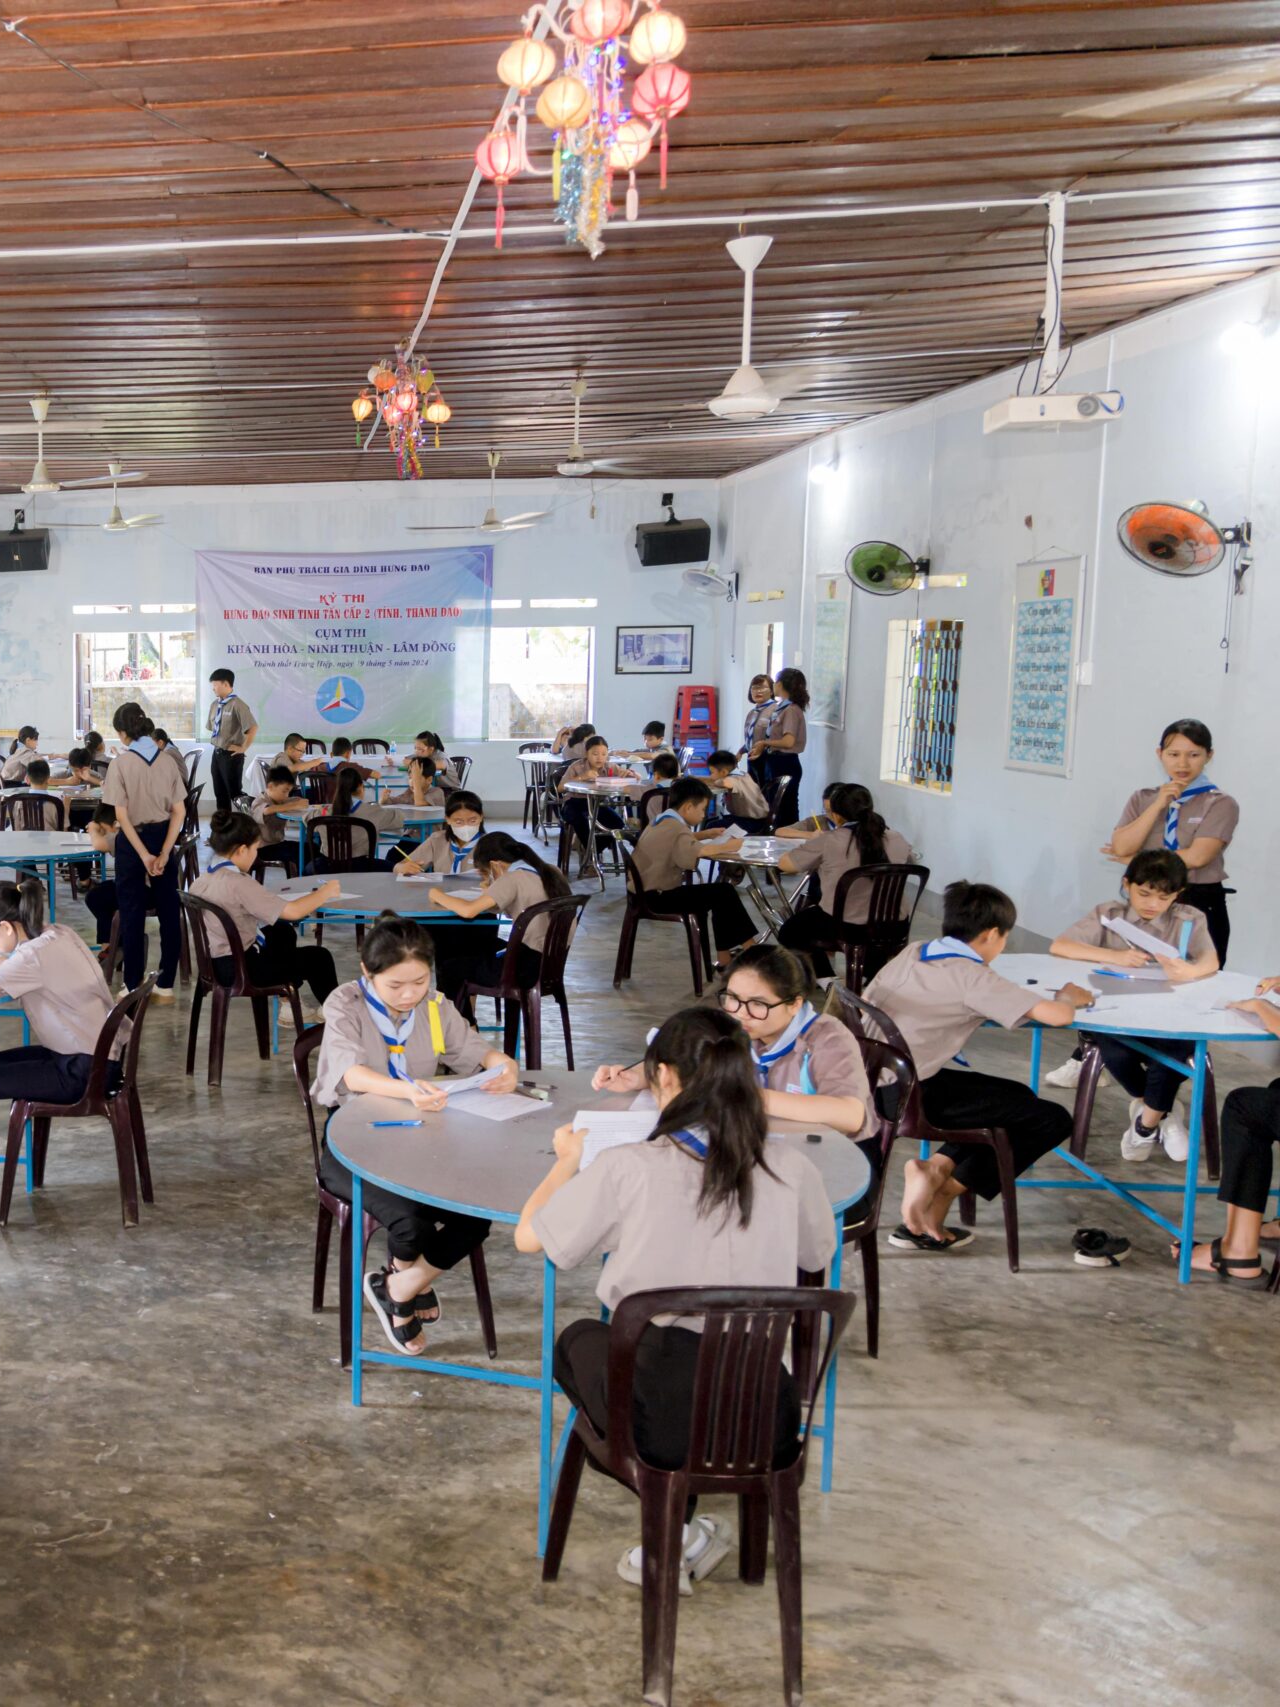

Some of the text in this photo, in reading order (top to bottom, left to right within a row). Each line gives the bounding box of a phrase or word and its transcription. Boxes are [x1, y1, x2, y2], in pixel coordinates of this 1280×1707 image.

[254, 566, 273, 575] BAN
[276, 566, 296, 576] PHỤ
[333, 565, 350, 574] GIA
[341, 593, 366, 604] THI
[273, 609, 295, 620] SINH
[343, 605, 362, 620] CẤP
[365, 608, 371, 619] 2
[315, 628, 367, 641] CỤM THI
[227, 641, 270, 654] KHÁNH
[273, 641, 298, 654] HÒA
[308, 644, 339, 654] NINH
[341, 641, 384, 656] THUẬN
[393, 641, 419, 653] LÂM
[422, 640, 456, 653] ĐỒNG
